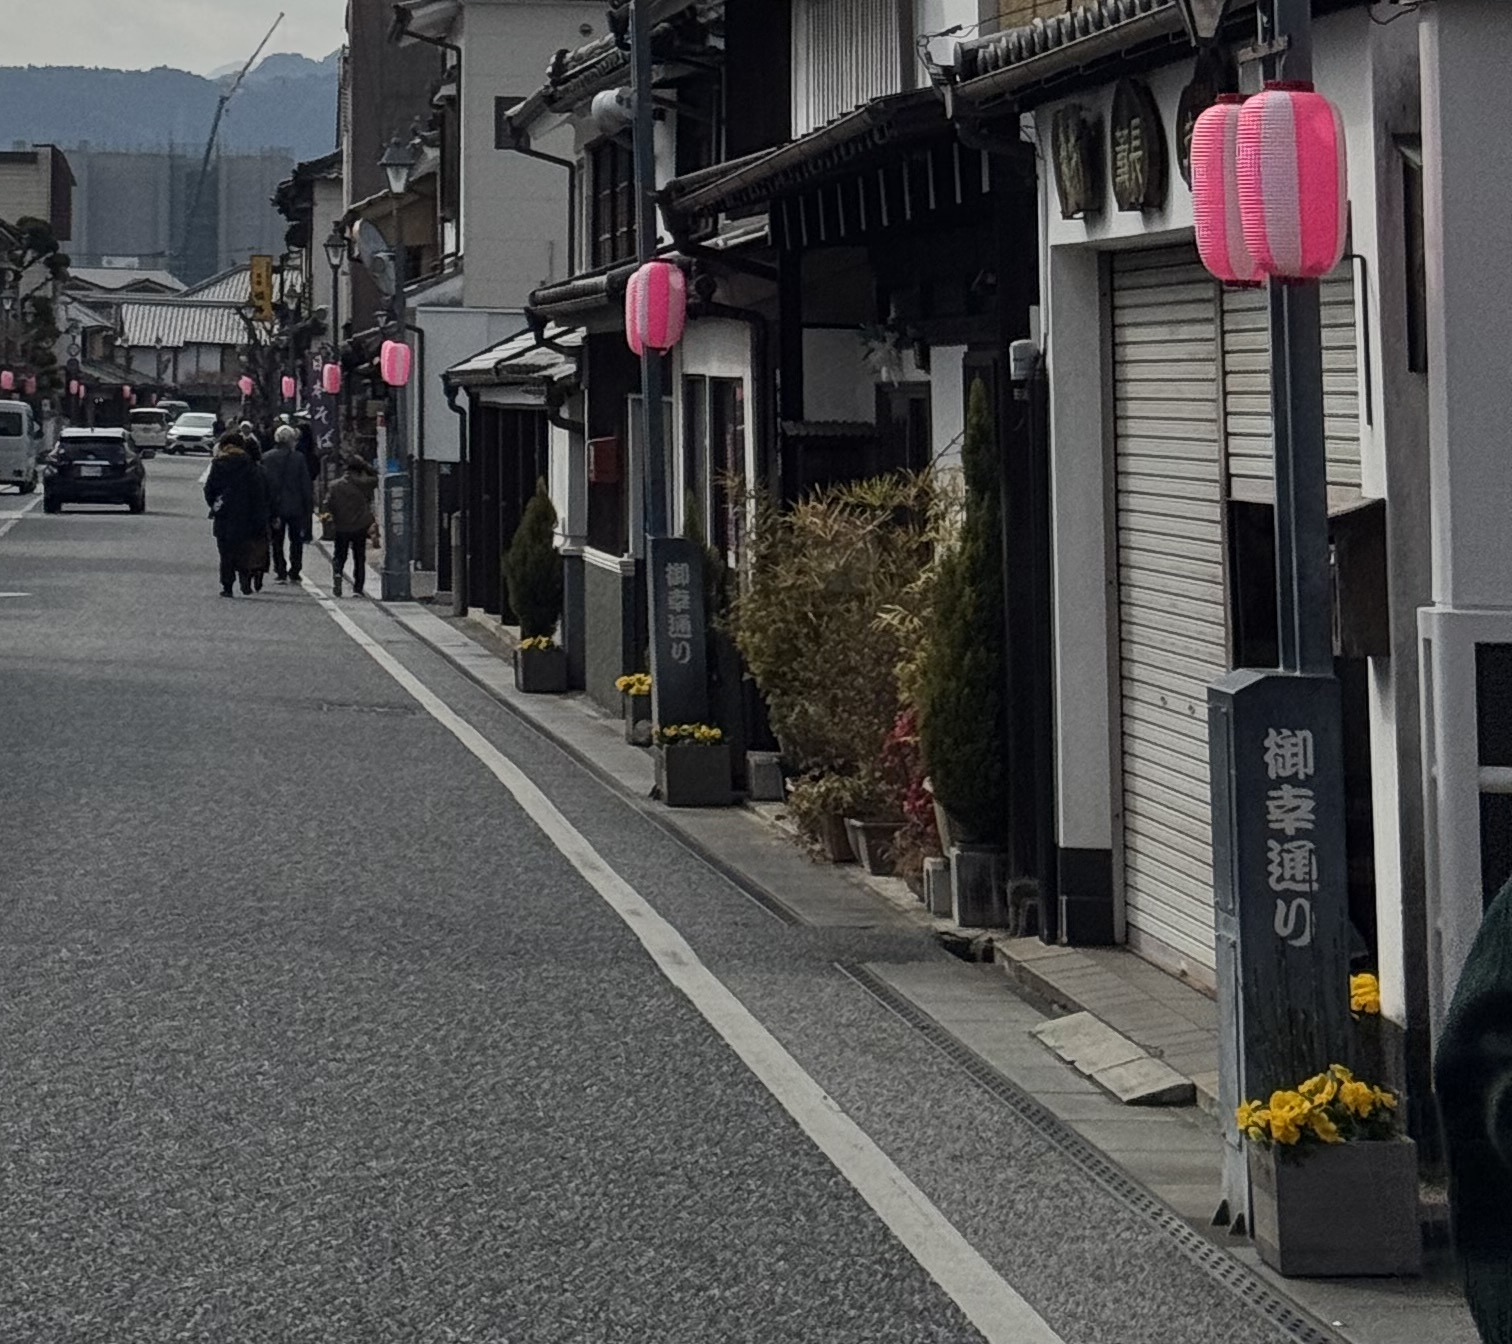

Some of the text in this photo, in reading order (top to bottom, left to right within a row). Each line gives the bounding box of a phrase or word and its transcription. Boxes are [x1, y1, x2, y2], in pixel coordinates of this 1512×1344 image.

[665, 562, 693, 664] 御幸通り
[1263, 727, 1319, 947] 御幸通り
